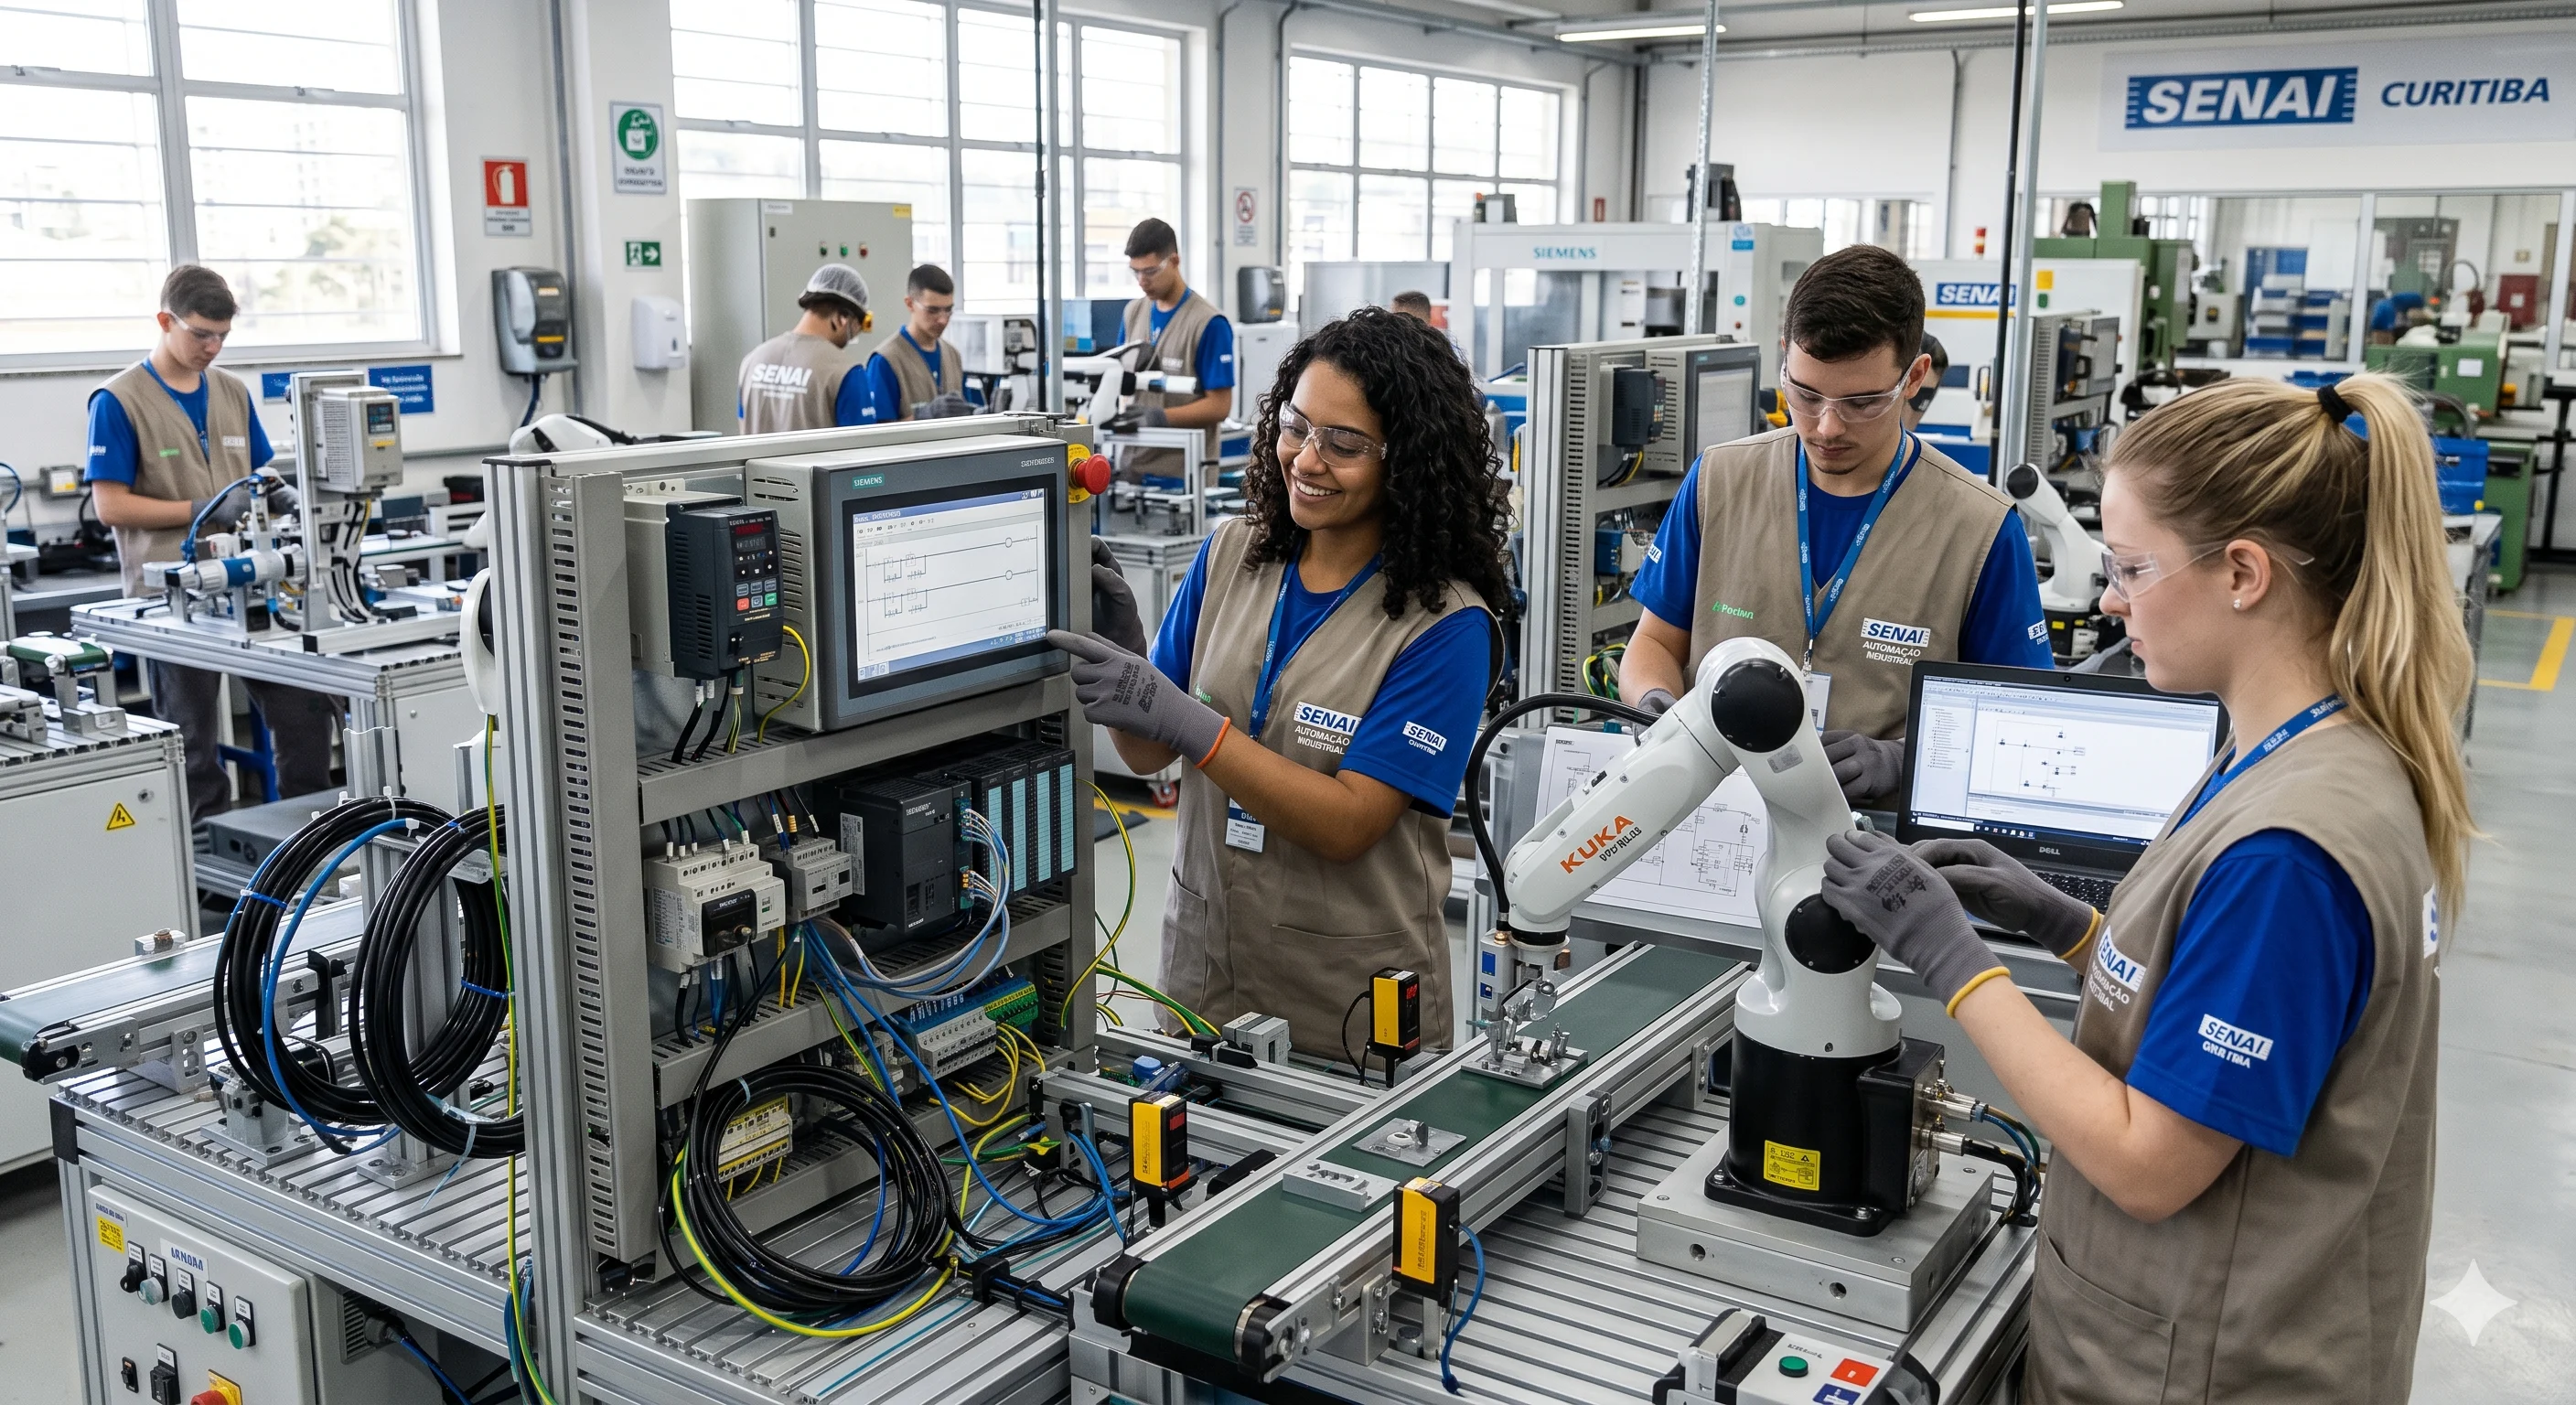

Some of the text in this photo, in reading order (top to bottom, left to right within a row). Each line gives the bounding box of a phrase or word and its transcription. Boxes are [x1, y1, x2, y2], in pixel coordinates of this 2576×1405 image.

[2142, 75, 2550, 123] SENAI CURITIBA
[1533, 247, 1596, 259] SIEMENS
[752, 363, 812, 387] SENAI
[853, 476, 883, 486] SIEMENS
[1867, 623, 1925, 643] SENAI
[1299, 706, 1357, 733] SENAI
[1409, 725, 1444, 747] SENAI
[1560, 815, 1634, 874] KUKA
[2206, 1021, 2266, 1054] SENAI
